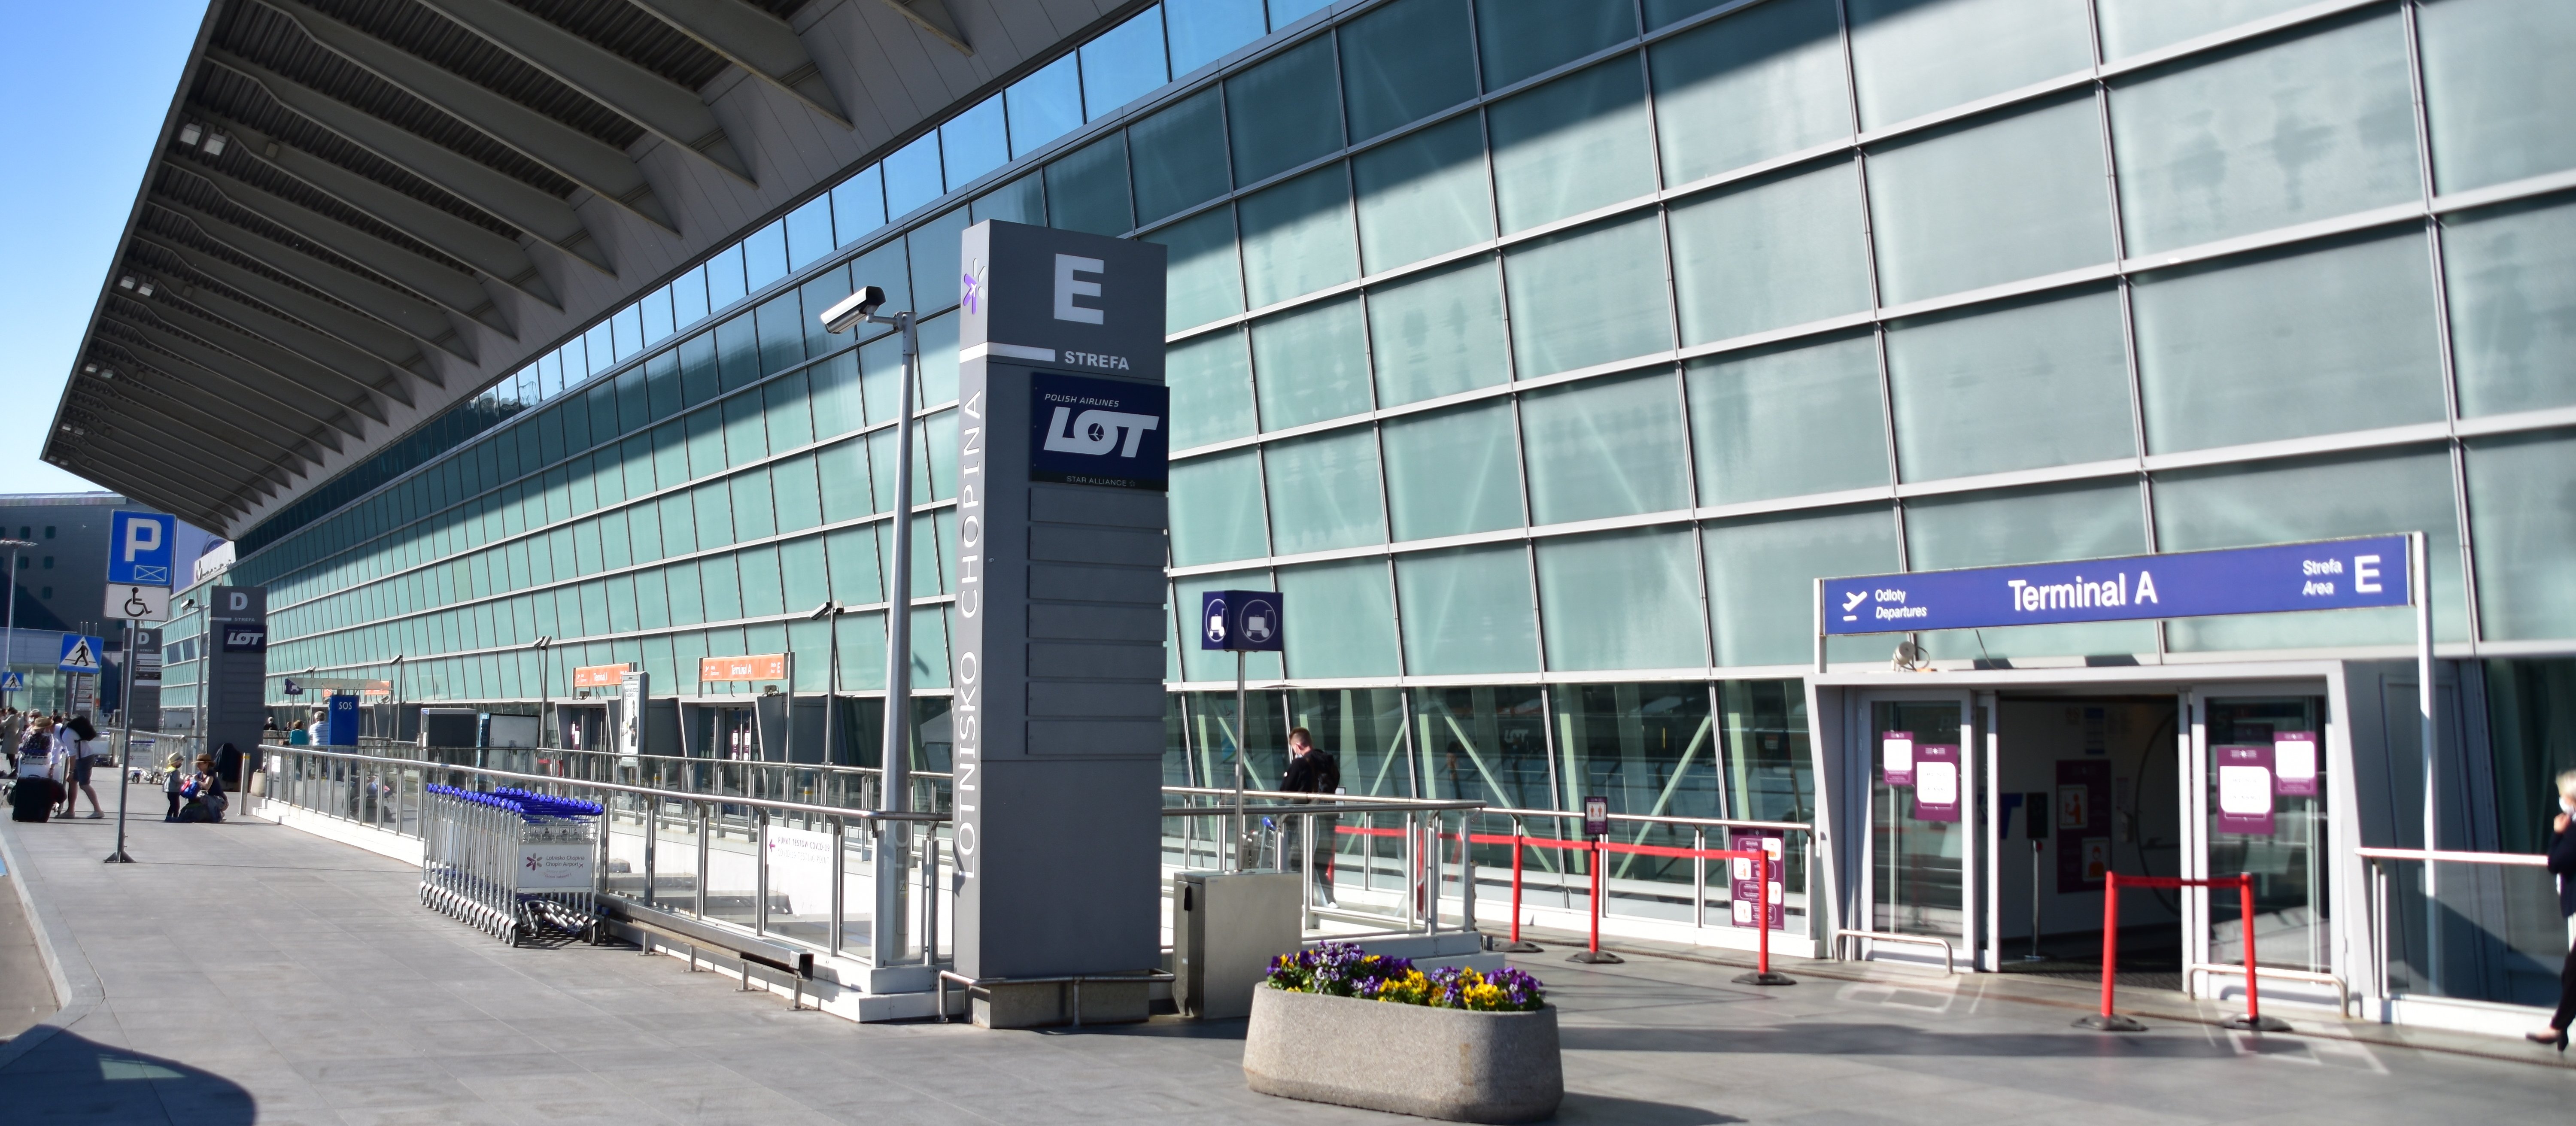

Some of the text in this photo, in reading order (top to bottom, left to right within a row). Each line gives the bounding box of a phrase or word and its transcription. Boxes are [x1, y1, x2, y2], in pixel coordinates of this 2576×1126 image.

[1054, 253, 1104, 325] E
[1065, 351, 1130, 370] STREFA
[1045, 393, 1120, 407] POLISH AIRLINES
[1043, 406, 1160, 458] LOT
[1089, 478, 1127, 486] ALLIANCE
[125, 517, 162, 561] P
[2302, 558, 2343, 576] Strefa
[2354, 555, 2382, 593] E
[2008, 571, 2158, 611] Terminal A
[2302, 580, 2334, 596] Area
[230, 592, 248, 610] D
[1875, 589, 1906, 604] Odloty
[1875, 606, 1927, 621] Departures
[137, 632, 150, 644] D
[227, 632, 264, 645] LOT
[958, 389, 981, 879] LOTNISKO CHOPINA
[731, 664, 752, 675] Terminal A
[777, 662, 781, 673] E
[339, 701, 352, 710] SOS
[778, 836, 790, 845] PUNKT
[810, 841, 830, 852] COVID-19
[798, 851, 815, 862] TESTING
[817, 855, 829, 865] POINT
